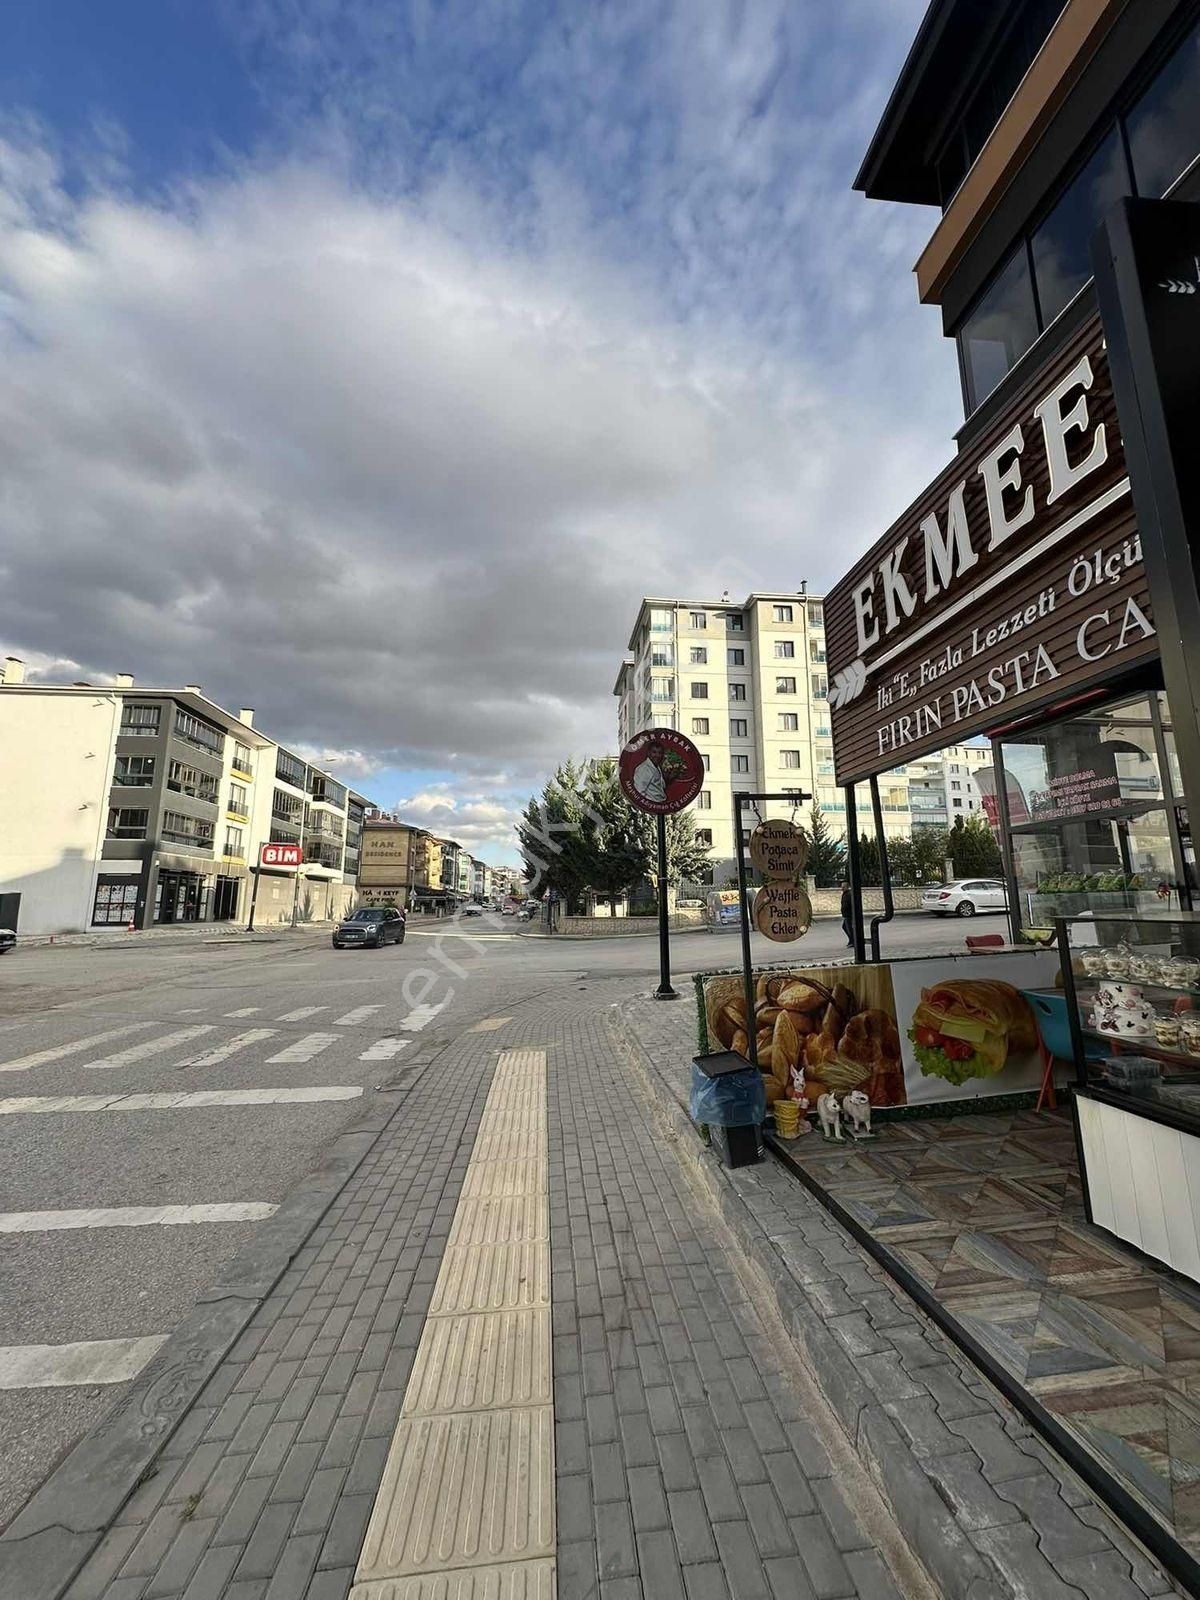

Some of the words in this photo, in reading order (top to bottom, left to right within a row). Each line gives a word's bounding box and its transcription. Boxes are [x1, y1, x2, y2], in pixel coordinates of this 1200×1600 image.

[851, 340, 1122, 658] EKMEE
[877, 685, 893, 711] İki
[920, 646, 963, 687] Fazla
[971, 587, 1056, 658] Lezzeti
[877, 697, 942, 757] FIRIN
[951, 643, 1061, 723] PASTA
[1076, 596, 1157, 661] CA
[762, 827, 796, 839] Ekmek
[761, 842, 798, 858] Poğaça
[768, 859, 794, 871] Simit
[766, 889, 800, 904] Waffle
[770, 905, 798, 918] Pasta
[771, 922, 798, 934] Ekler
